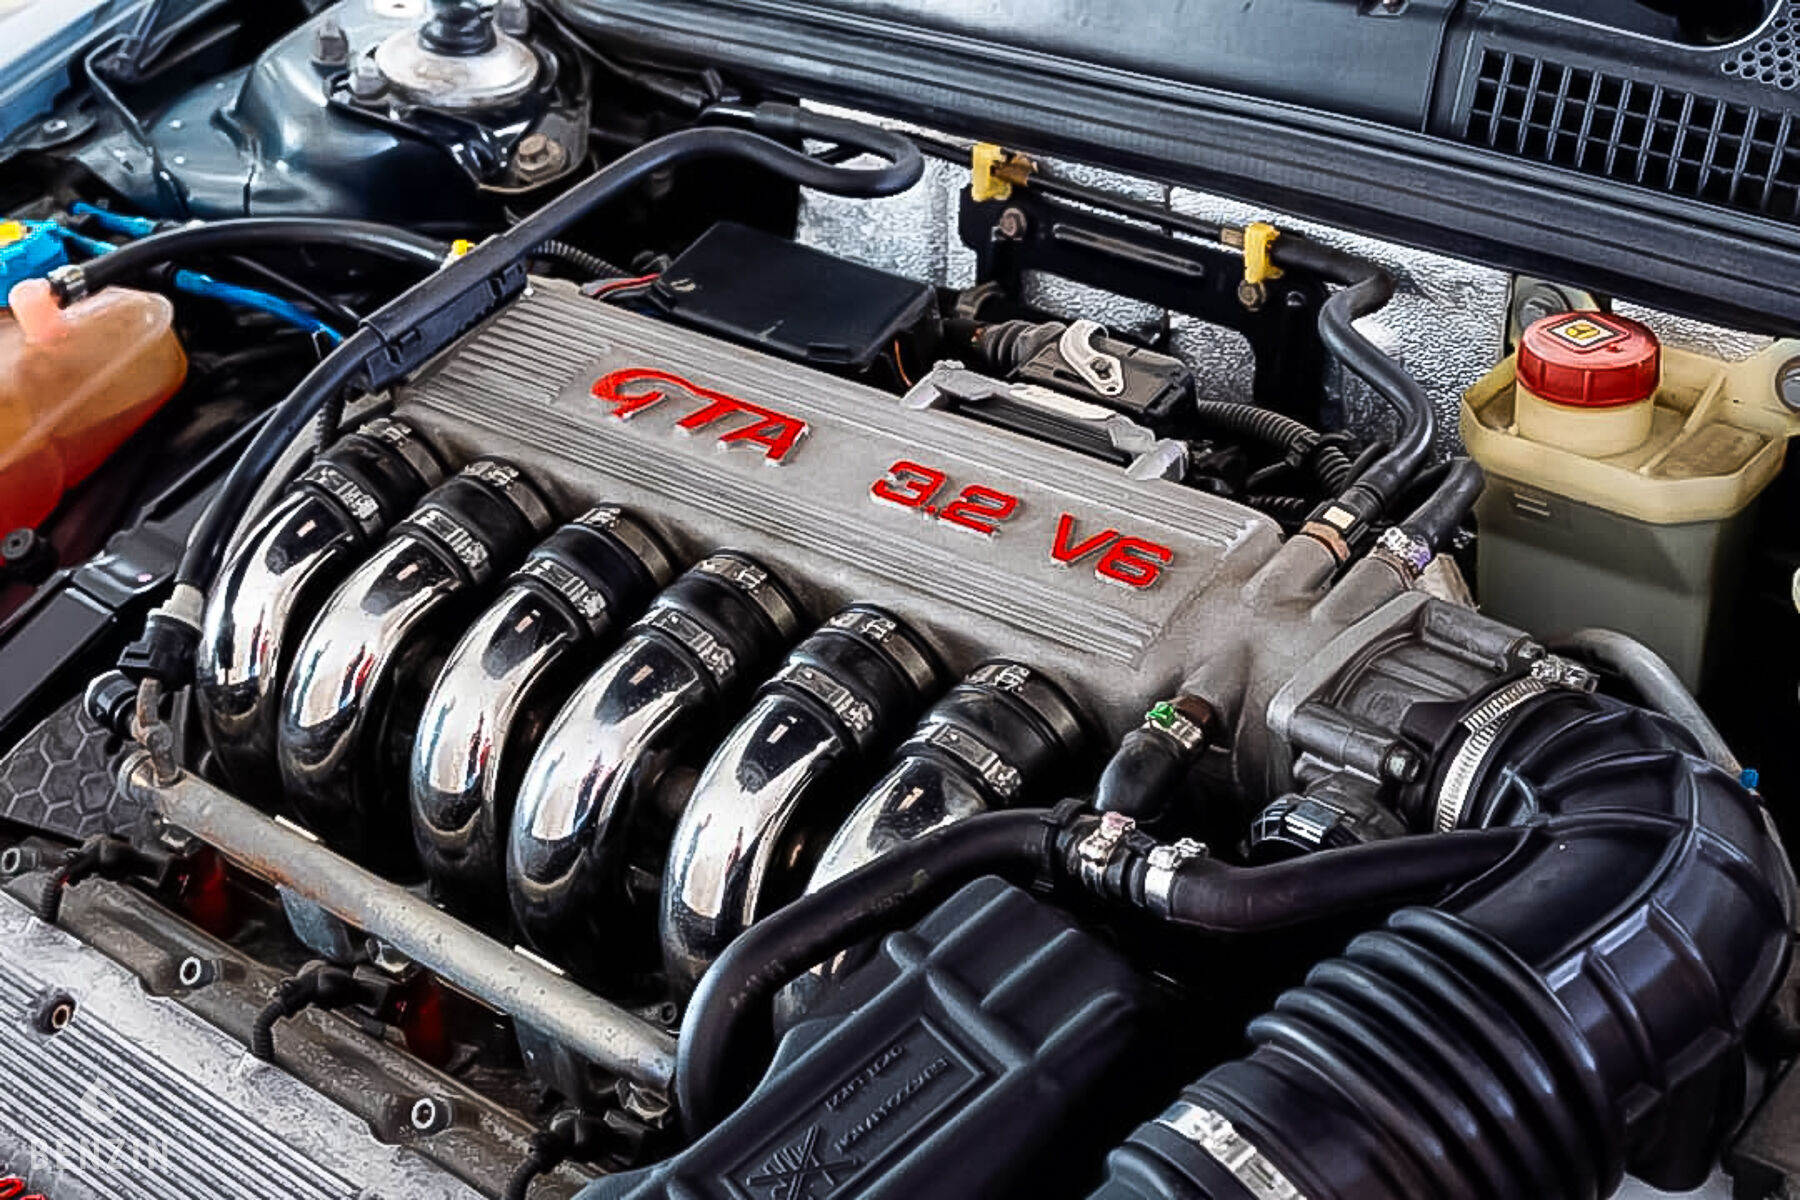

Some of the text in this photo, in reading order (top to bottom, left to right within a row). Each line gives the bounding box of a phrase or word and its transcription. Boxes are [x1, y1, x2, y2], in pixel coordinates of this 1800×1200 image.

[590, 367, 1174, 589] GTA 3.2 V6
